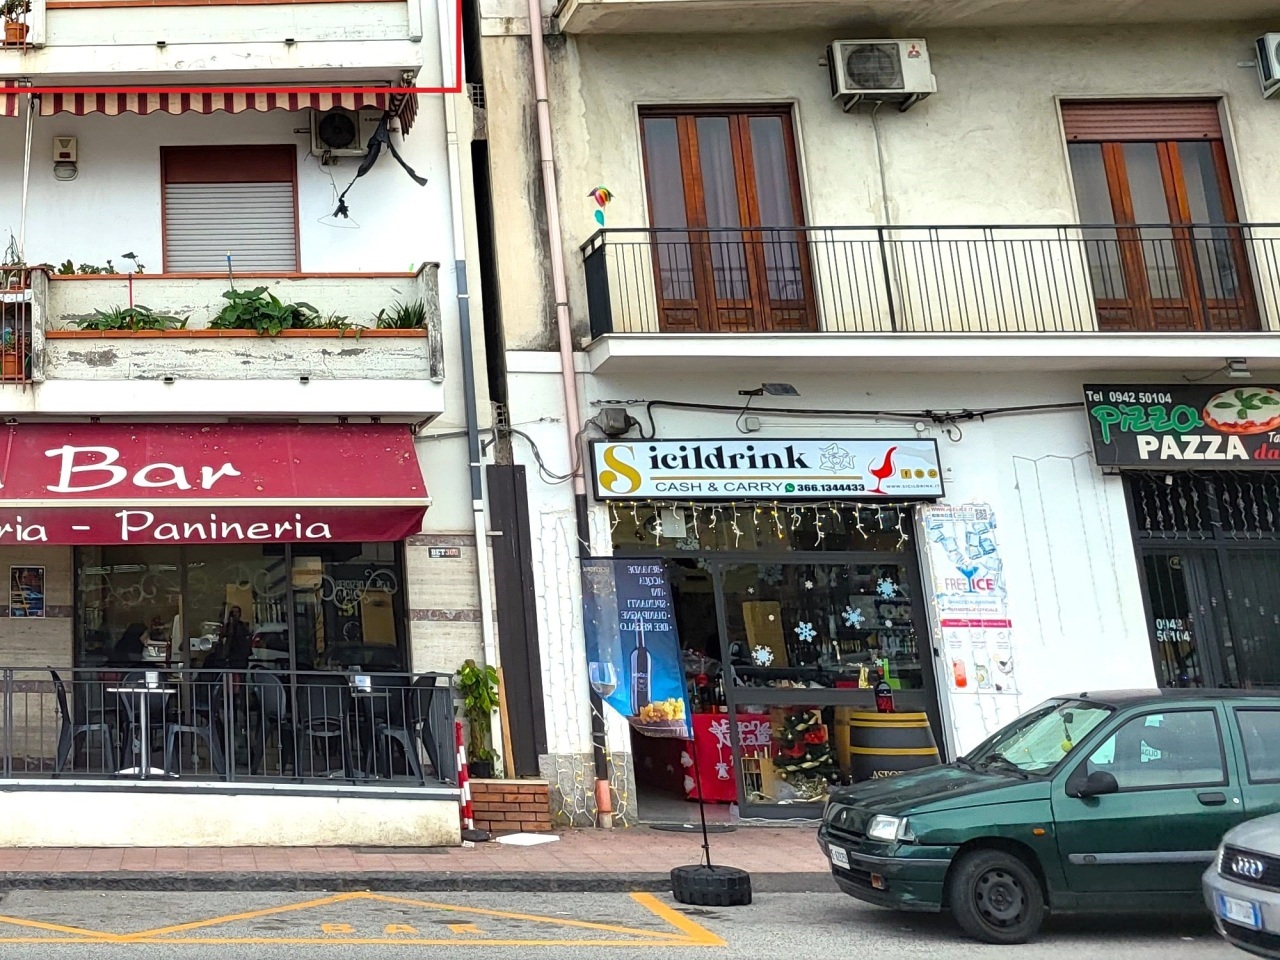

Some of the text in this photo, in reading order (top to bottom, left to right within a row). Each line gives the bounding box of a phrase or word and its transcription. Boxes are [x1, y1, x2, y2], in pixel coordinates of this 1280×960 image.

[1086, 390, 1172, 404] Tel 0942 50104
[1136, 434, 1250, 461] PAZZA
[44, 444, 242, 493] Bar
[655, 482, 865, 492] CASH & CARRY 366.1344433
[114, 509, 332, 541] Panineria
[971, 578, 995, 591] ICE
